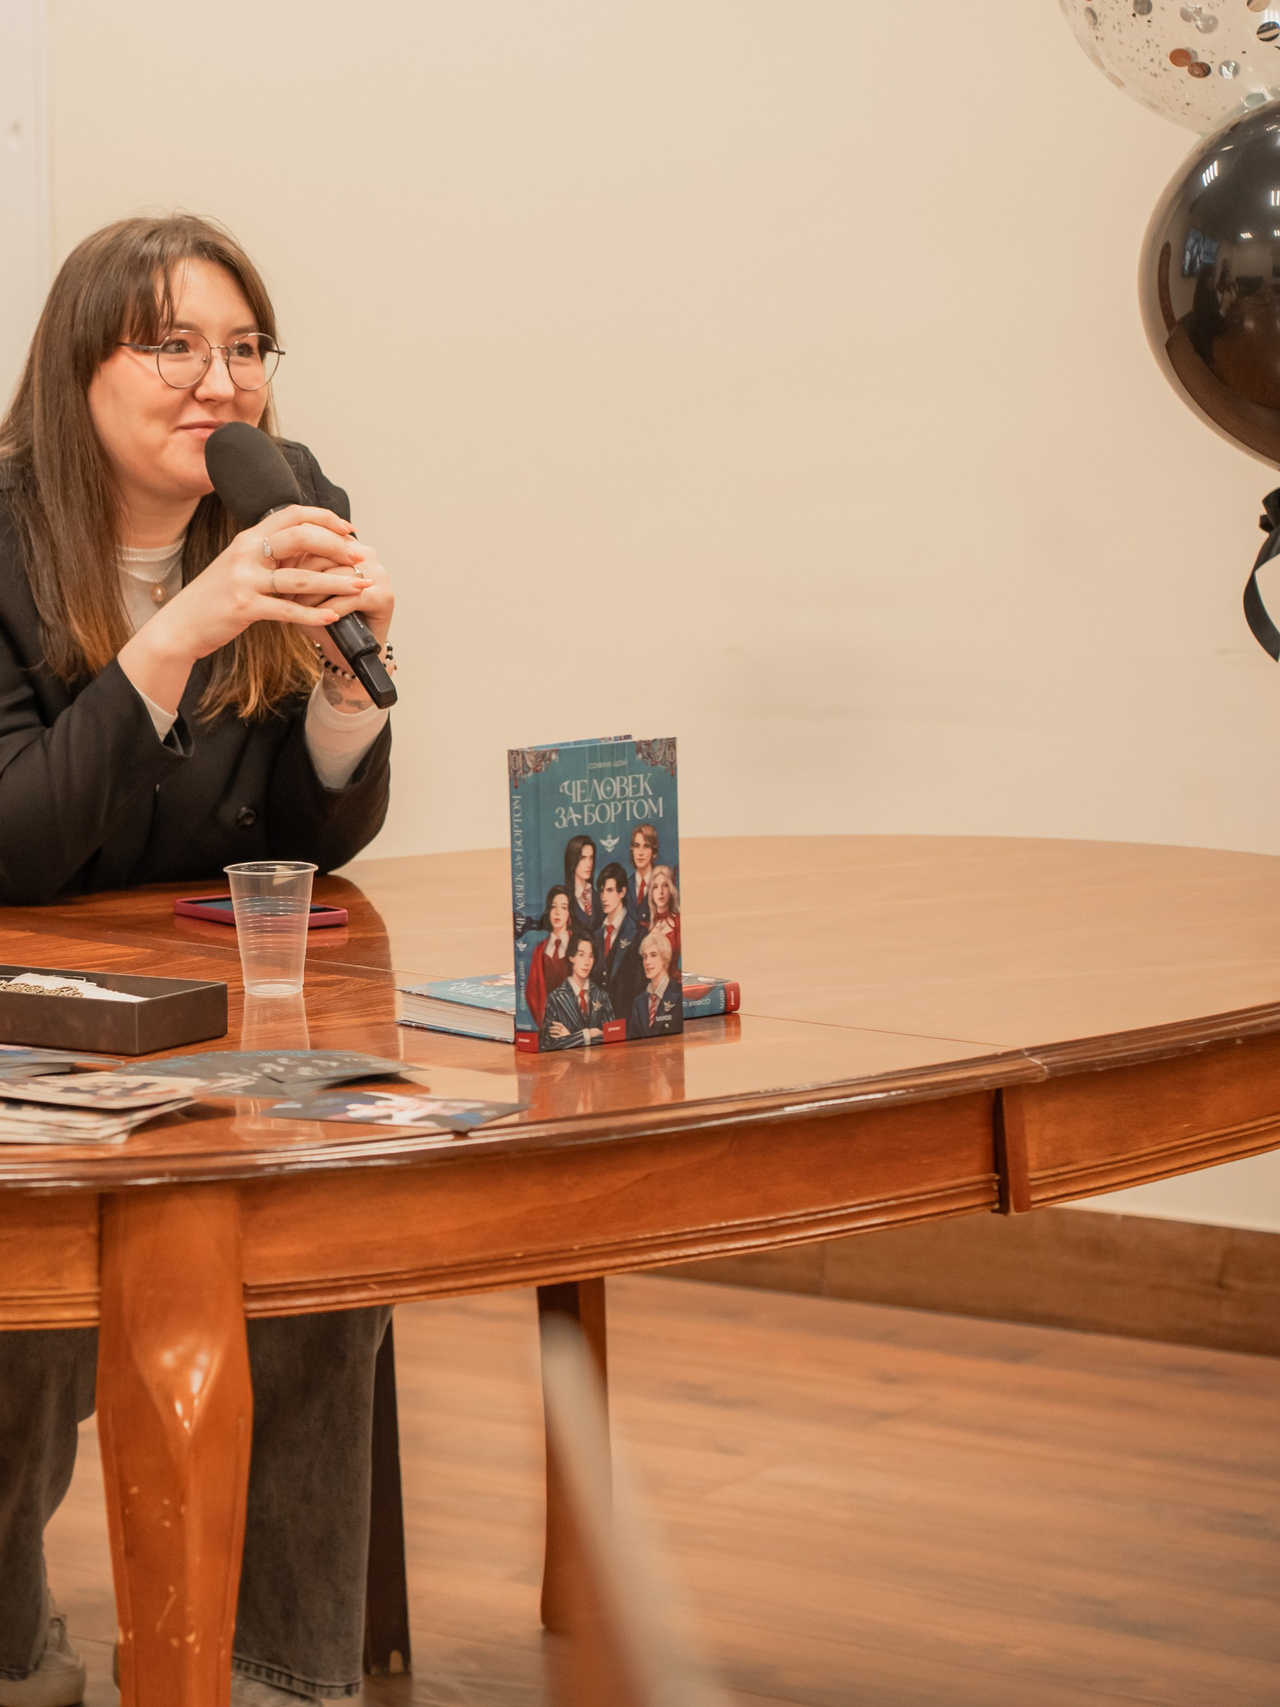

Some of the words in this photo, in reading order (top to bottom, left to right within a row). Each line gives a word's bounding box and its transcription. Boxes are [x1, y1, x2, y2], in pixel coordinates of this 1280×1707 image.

[559, 773, 653, 803] ЧЕЛОВЕК
[512, 795, 524, 853] БОРТОМ
[554, 806, 582, 829] ЗА
[583, 796, 664, 826] БОРТОМ
[515, 871, 526, 932] ЧЕЛОВЕК
